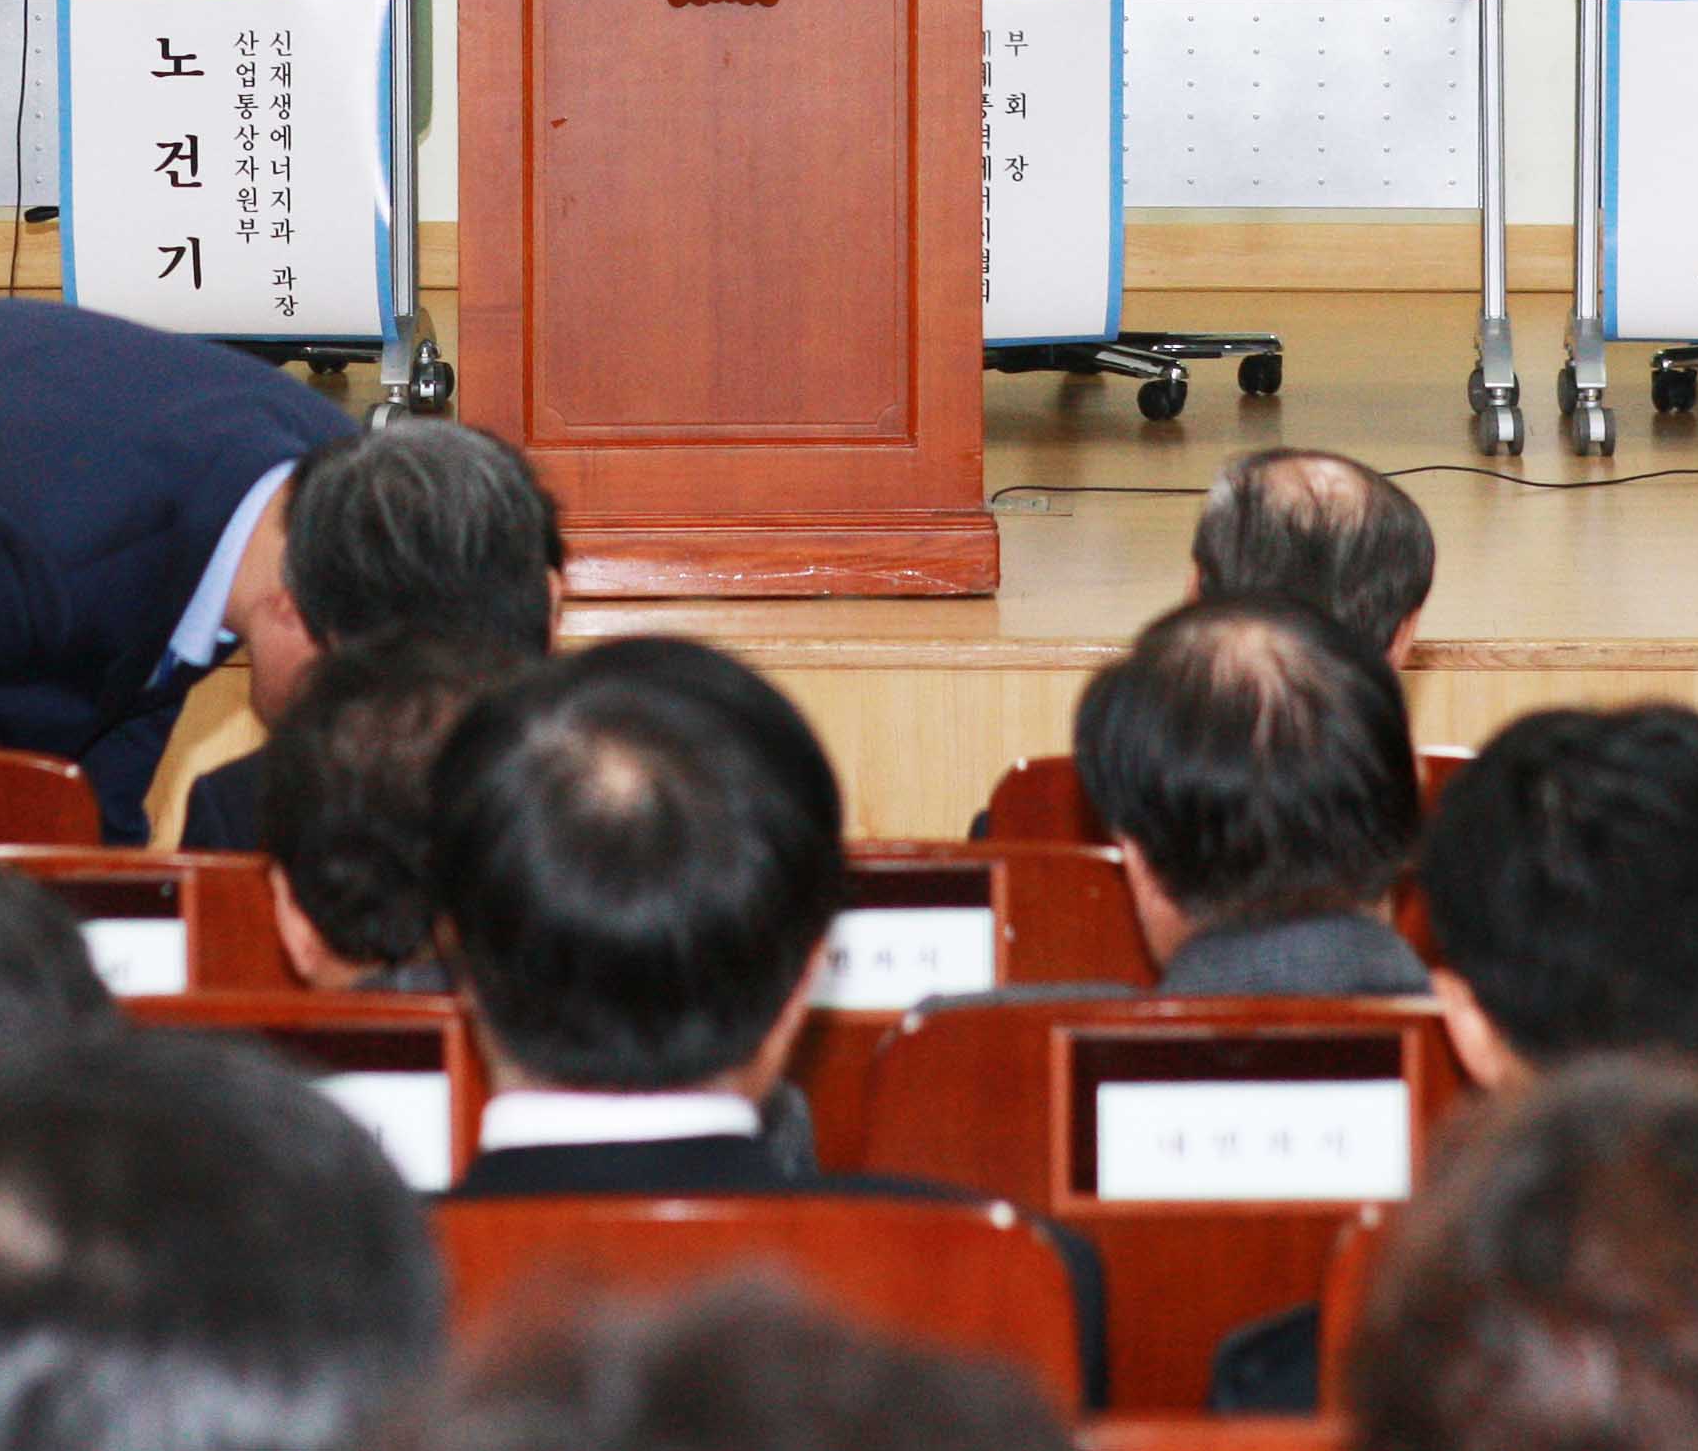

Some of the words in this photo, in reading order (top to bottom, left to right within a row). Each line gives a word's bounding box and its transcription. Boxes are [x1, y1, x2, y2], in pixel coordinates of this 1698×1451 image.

[234, 29, 261, 246] 산업통상자원부
[269, 29, 296, 246] 신재생에너지과
[272, 265, 299, 318] 과장
